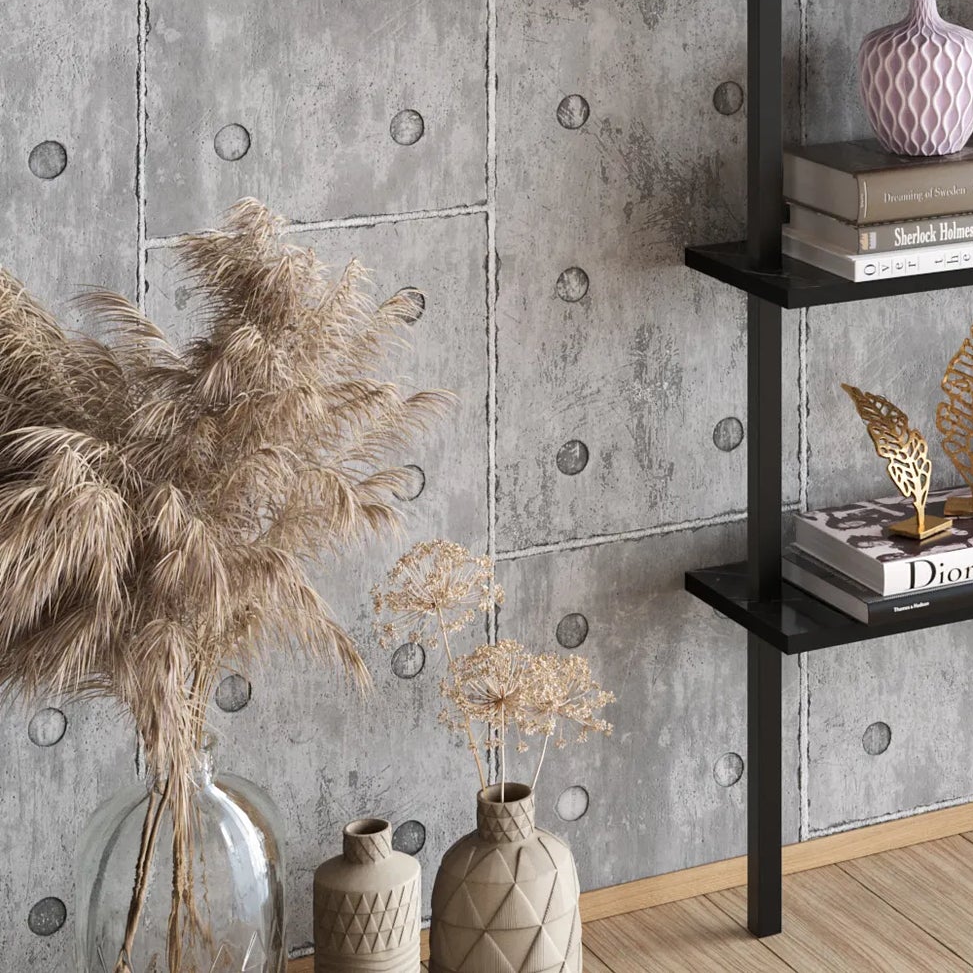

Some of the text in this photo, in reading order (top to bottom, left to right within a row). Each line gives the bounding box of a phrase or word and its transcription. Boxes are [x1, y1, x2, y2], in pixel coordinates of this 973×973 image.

[883, 184, 967, 204] Dreaming of Sweden
[893, 225, 937, 247] Sherlock
